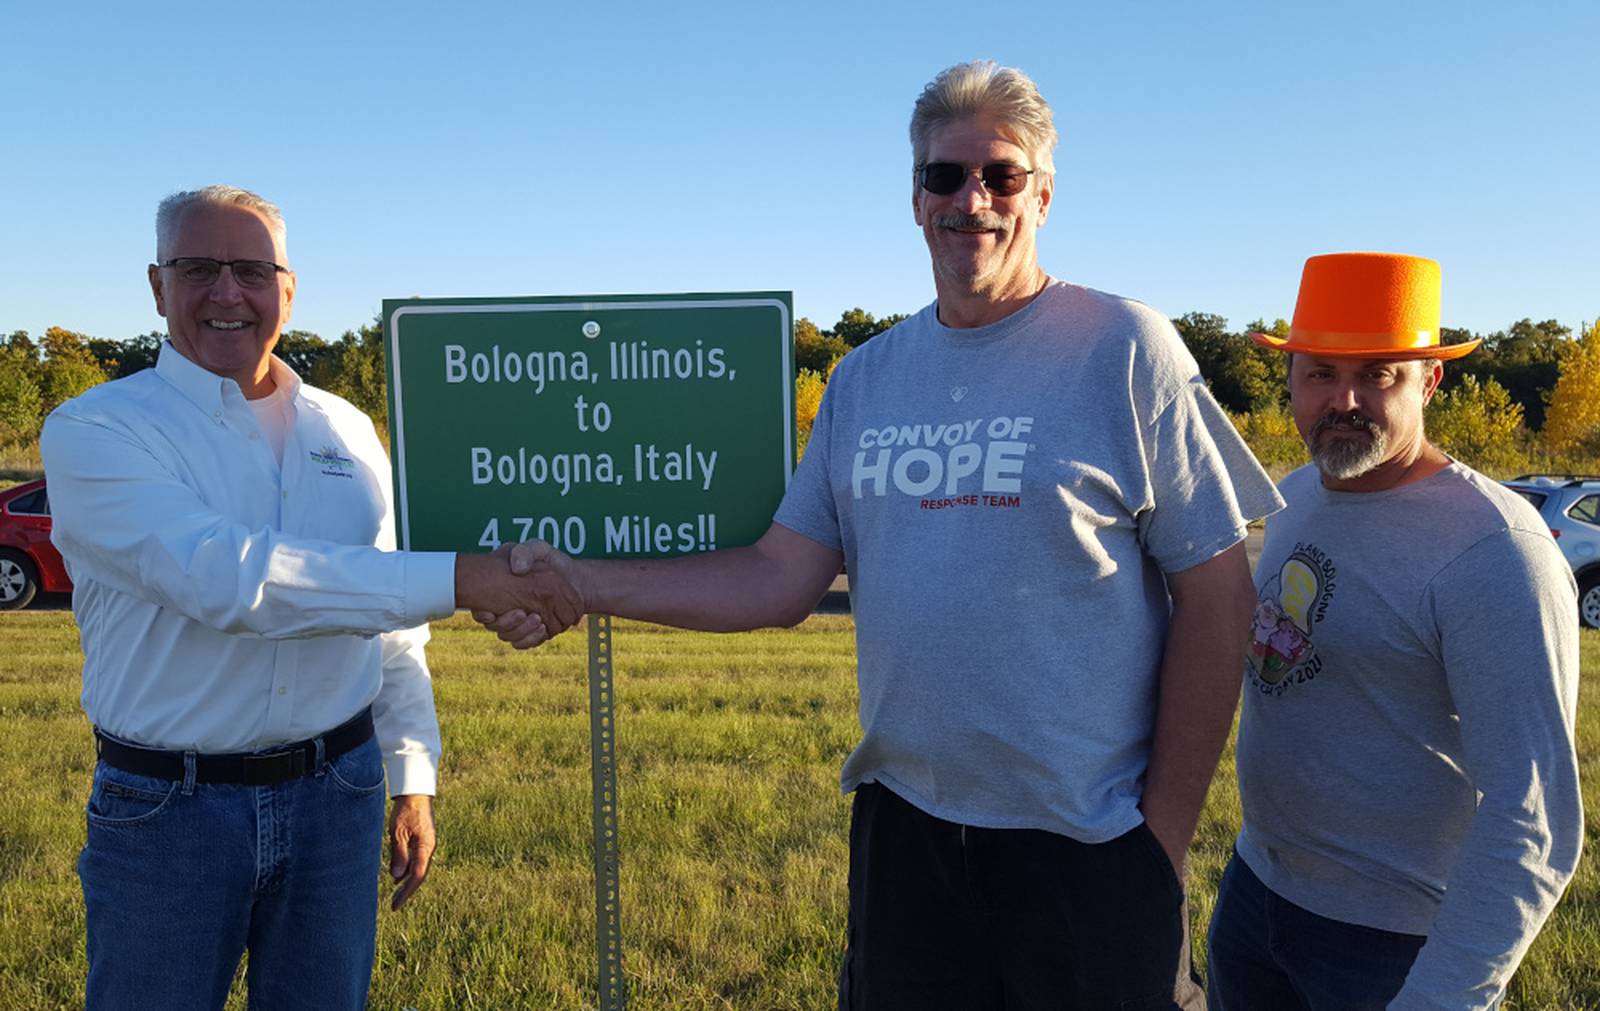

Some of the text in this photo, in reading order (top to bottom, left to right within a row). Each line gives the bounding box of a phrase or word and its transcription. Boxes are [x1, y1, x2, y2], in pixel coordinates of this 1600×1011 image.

[444, 340, 736, 395] Bologna, Illinois,
[574, 395, 612, 432] to
[858, 416, 1034, 449] CONVOY OF
[471, 443, 718, 497] Bologna, Italy
[852, 441, 1028, 499] HOPE
[920, 495, 1021, 510] RESPONSE TEAM
[477, 514, 717, 555] 4700 Miles!!
[1314, 558, 1337, 624] BOLOGNA
[1295, 654, 1323, 684] 2021
